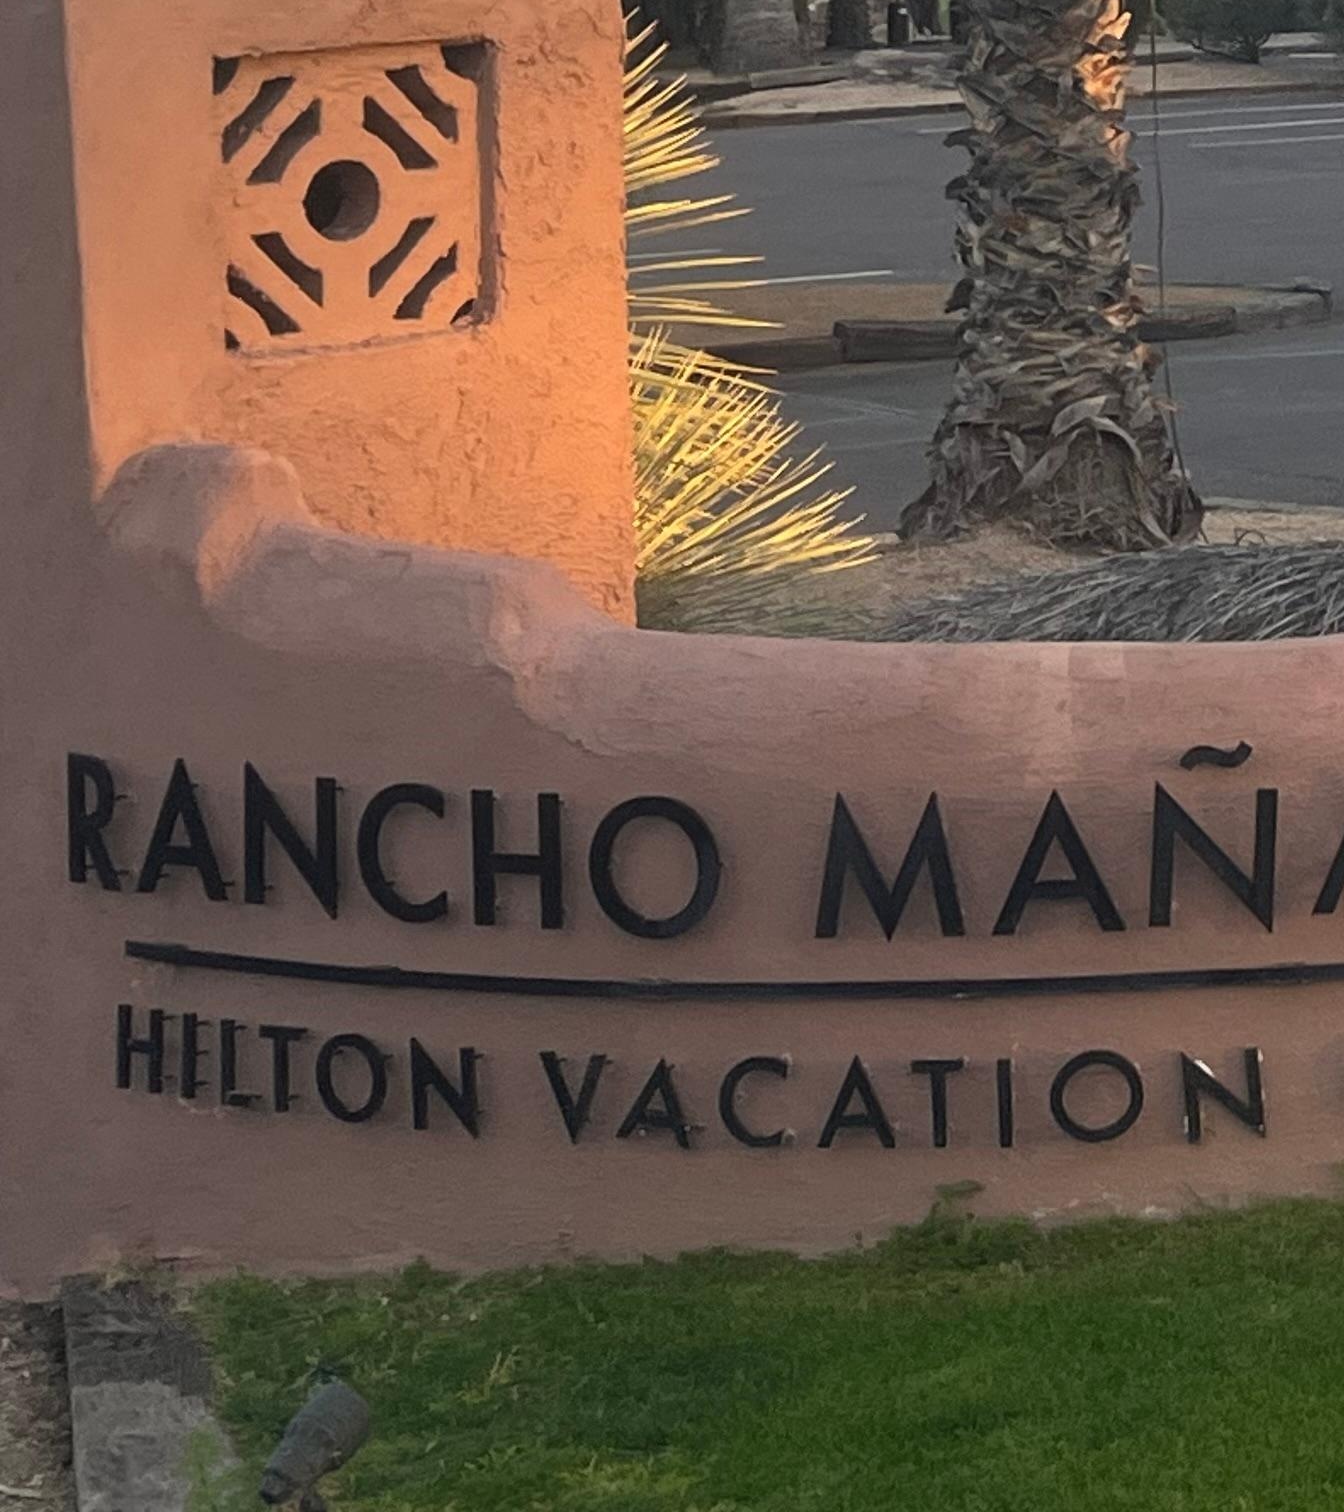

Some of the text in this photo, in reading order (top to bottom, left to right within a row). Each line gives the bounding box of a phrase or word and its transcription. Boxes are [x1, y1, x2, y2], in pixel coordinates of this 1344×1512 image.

[67, 752, 722, 940] RANCHO
[116, 1003, 480, 1139] HILTON
[539, 1045, 1267, 1150] VACATION
